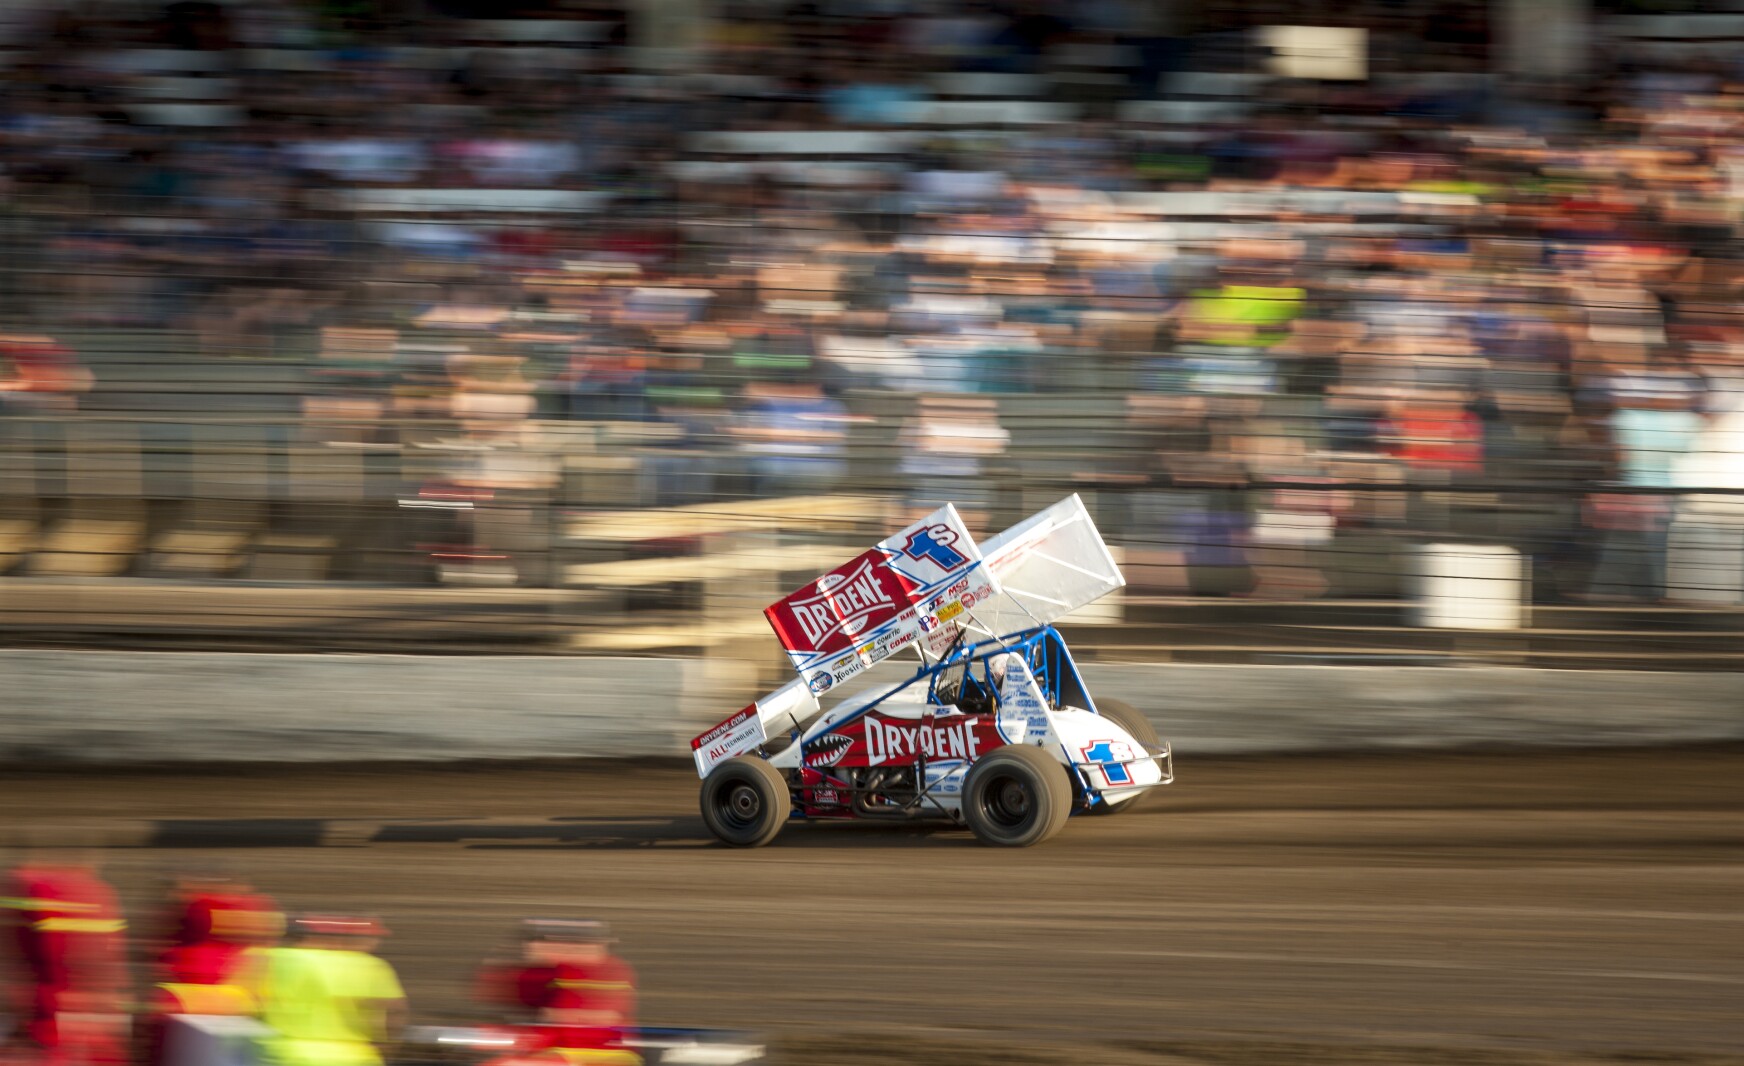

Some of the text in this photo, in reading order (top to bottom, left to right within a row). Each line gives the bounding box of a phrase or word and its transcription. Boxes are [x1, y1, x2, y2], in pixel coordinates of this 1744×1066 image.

[791, 563, 893, 646] DRYDENE
[700, 712, 747, 746] DRYDENE.COM
[864, 715, 981, 767] DRYDENE
